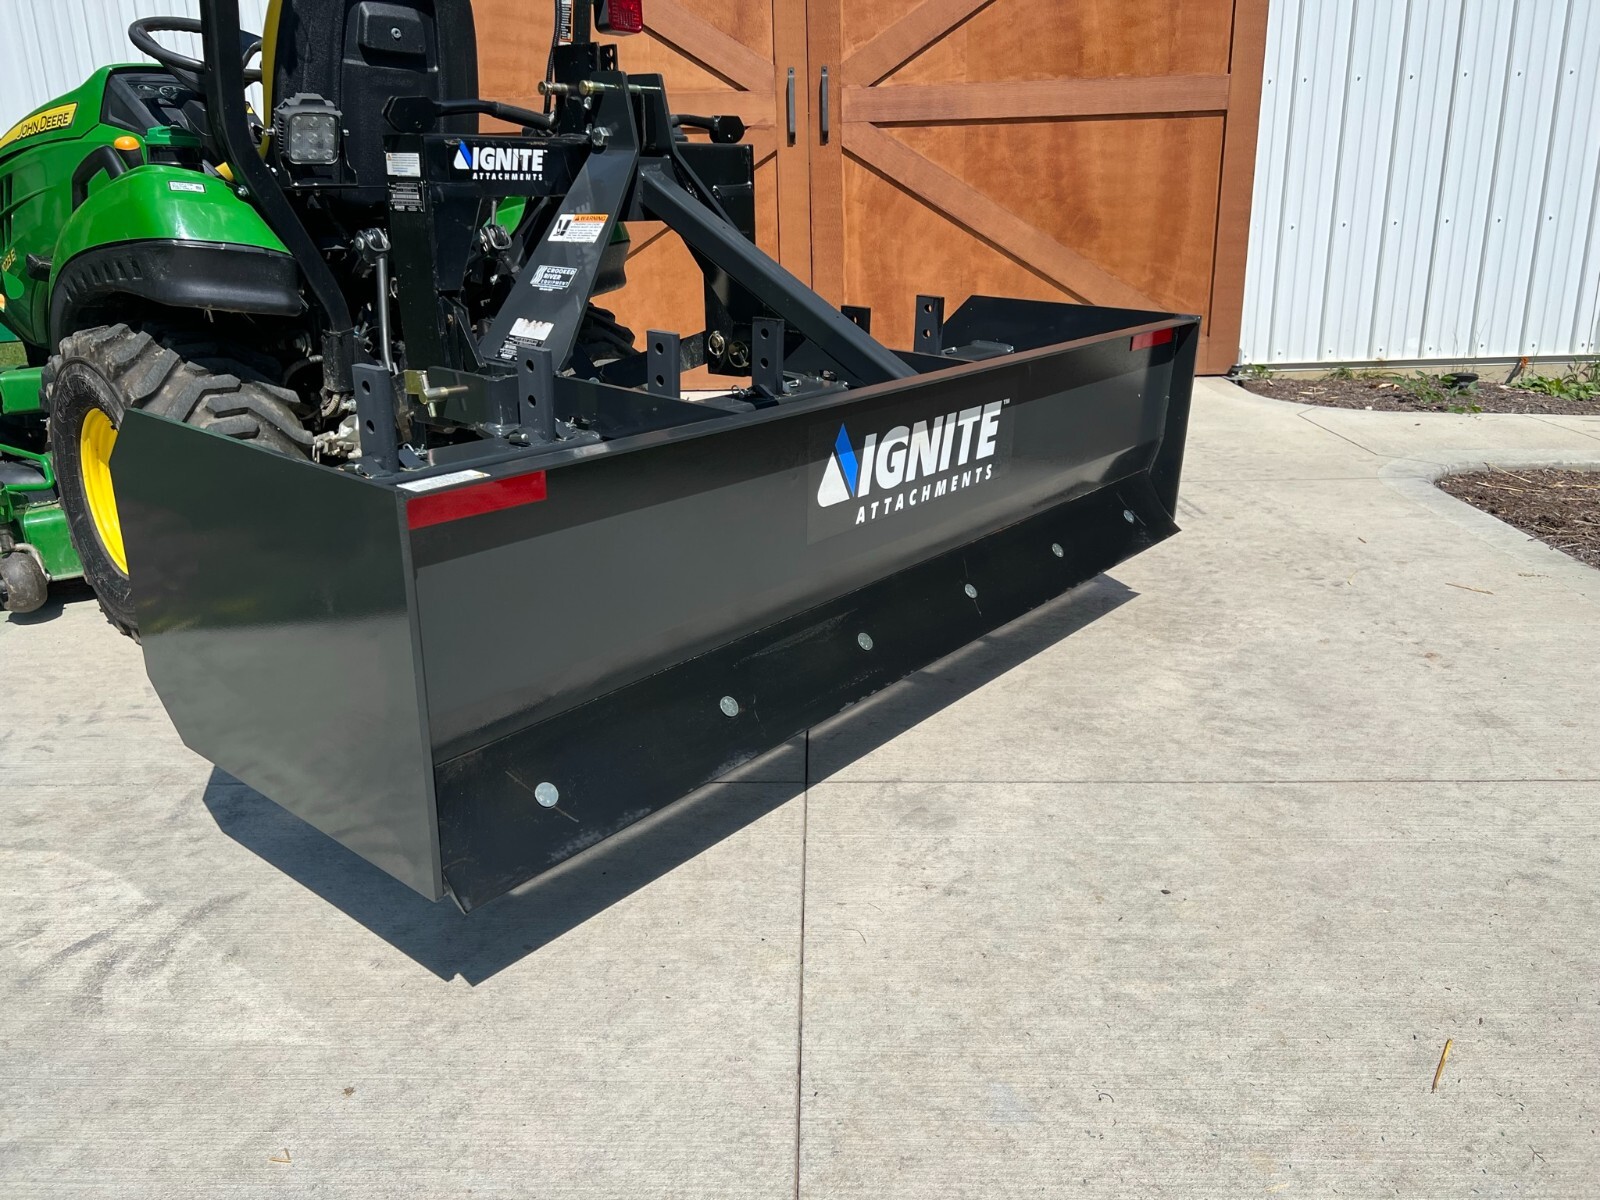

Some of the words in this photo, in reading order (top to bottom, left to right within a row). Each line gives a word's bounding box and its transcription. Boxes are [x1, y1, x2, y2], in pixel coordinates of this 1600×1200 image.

[17, 118, 40, 138] JOHN
[40, 112, 69, 130] DEERE
[472, 147, 543, 171] IGNITE
[472, 172, 543, 181] ATTACHMENTS
[546, 267, 575, 275] CROOKED
[857, 400, 1003, 498] IGNITE
[855, 463, 993, 525] ATTACHMENTS
